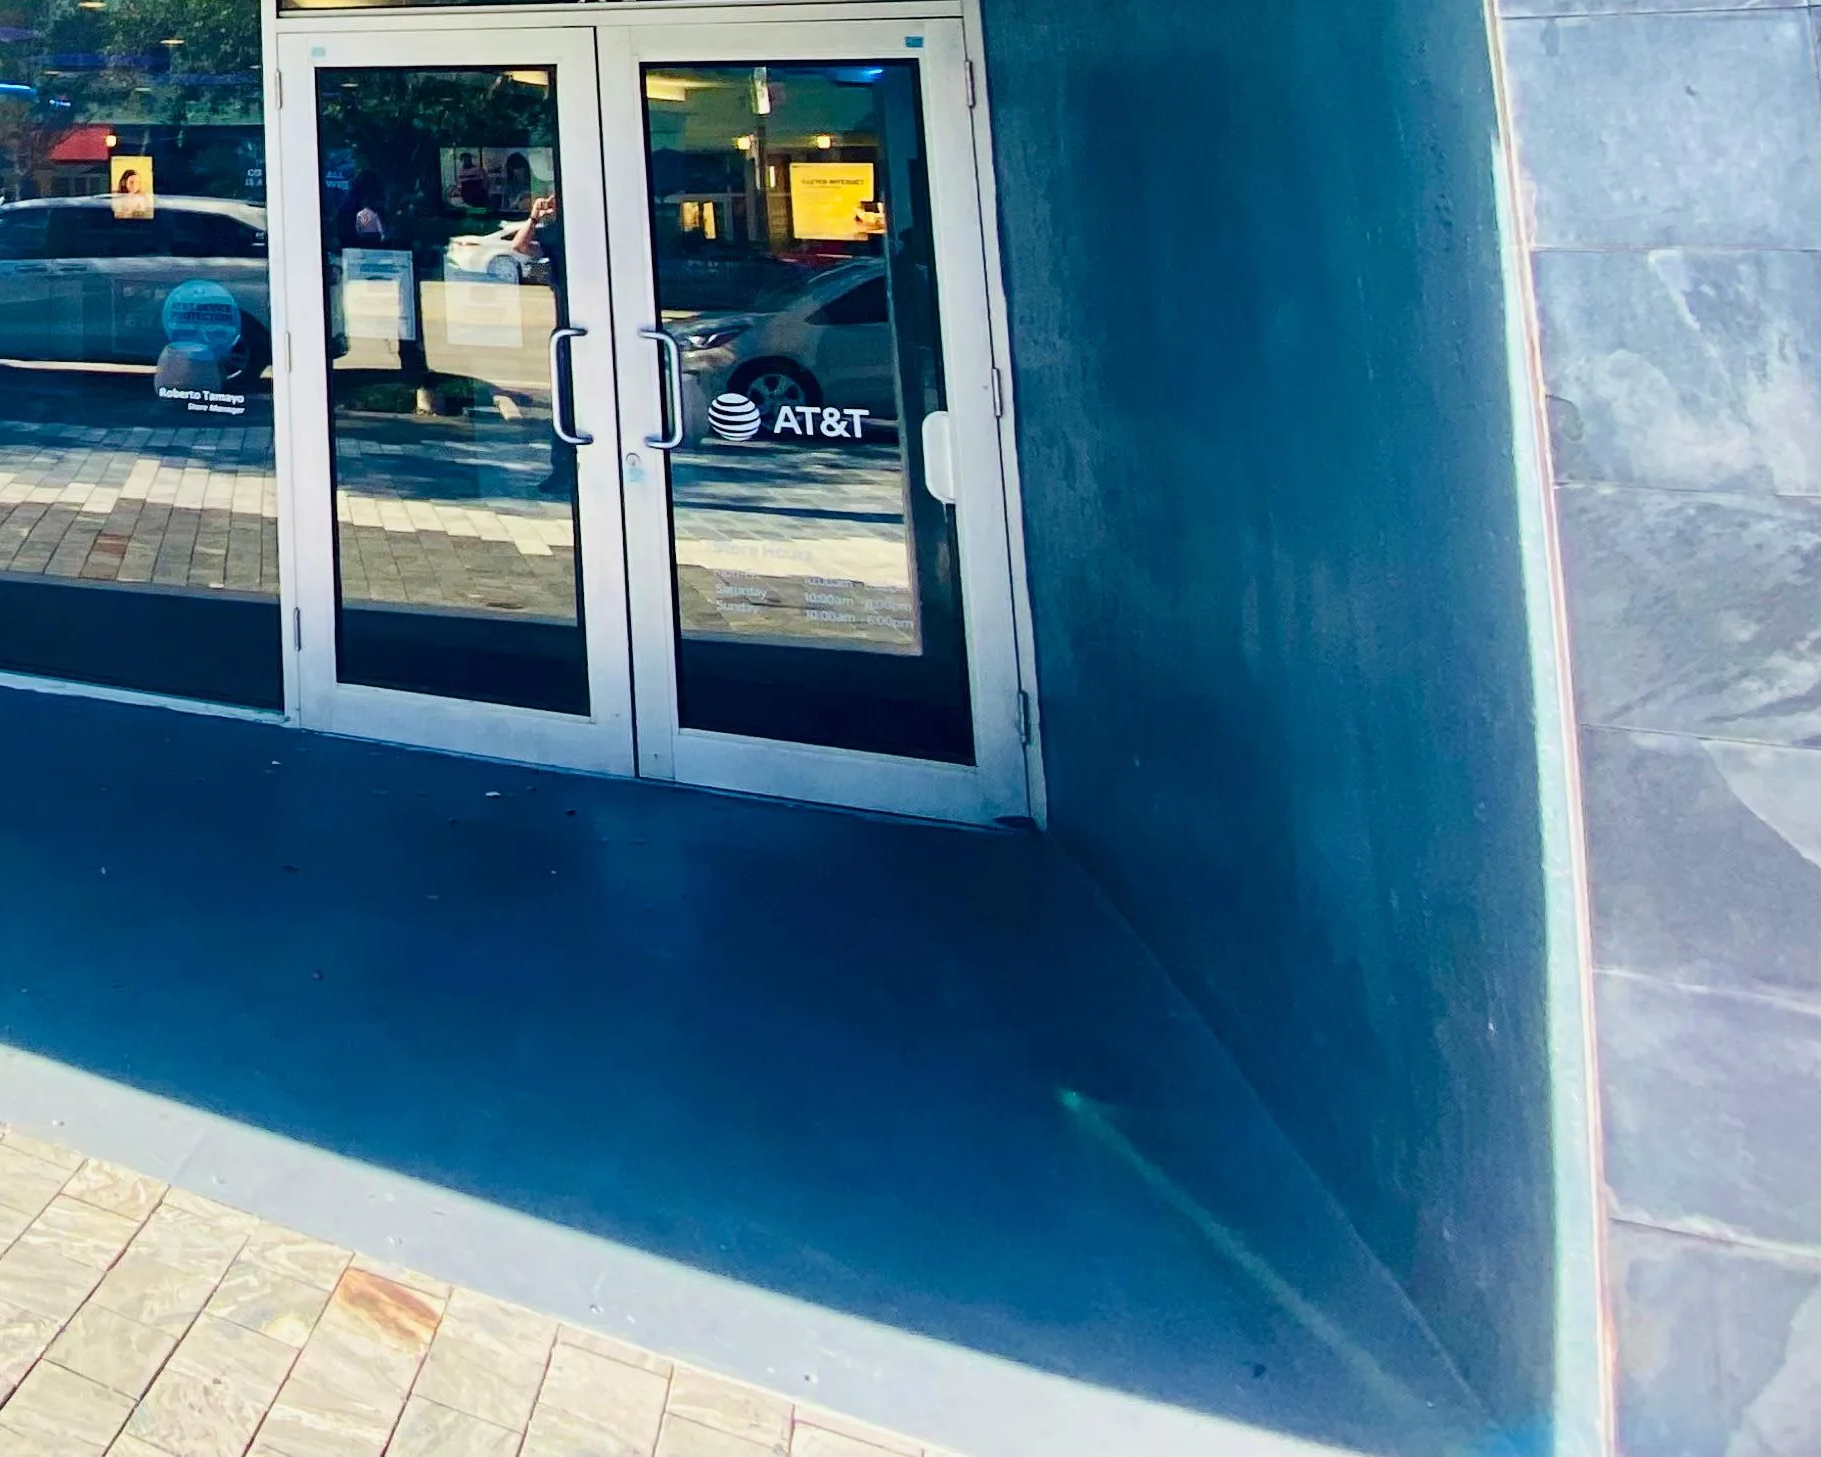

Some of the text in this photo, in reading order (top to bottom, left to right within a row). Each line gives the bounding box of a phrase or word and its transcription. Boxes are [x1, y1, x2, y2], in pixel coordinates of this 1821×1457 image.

[159, 387, 245, 405] Roberto Tamayo
[774, 405, 870, 438] AT&T
